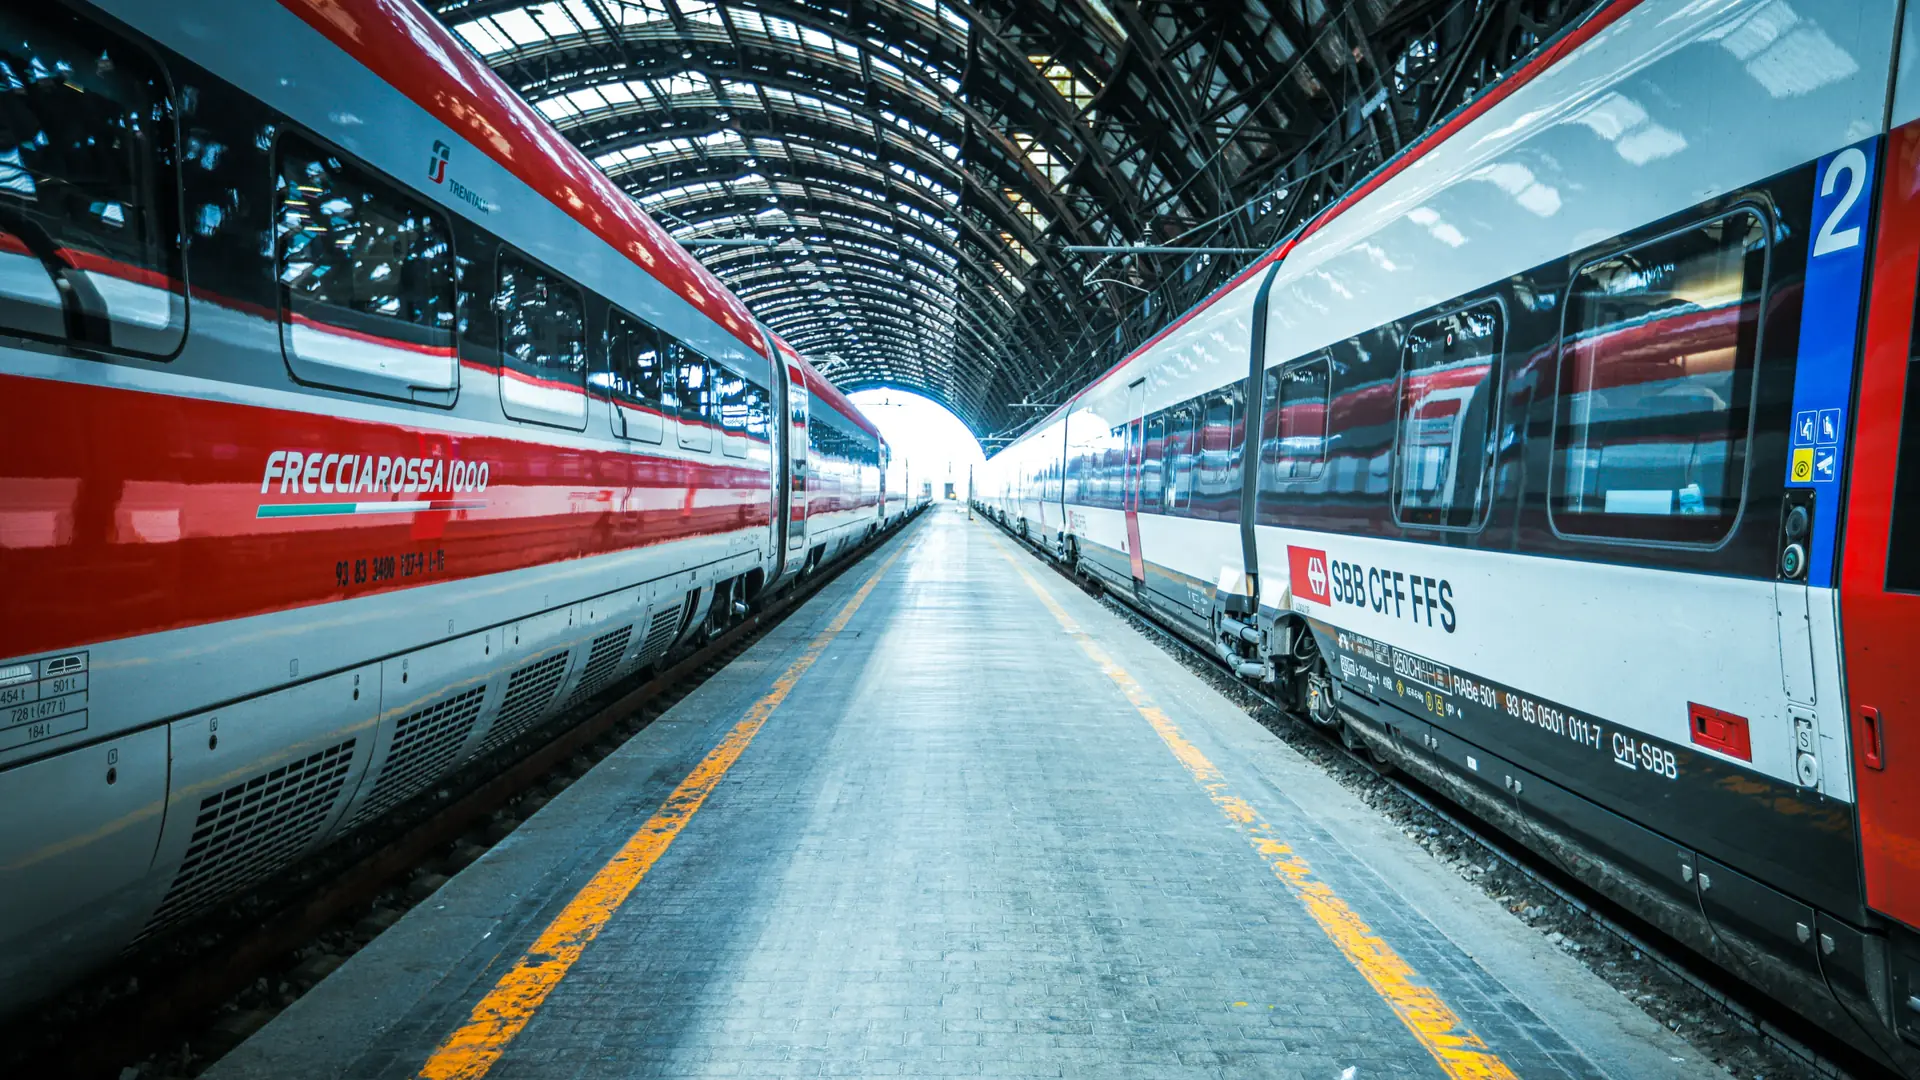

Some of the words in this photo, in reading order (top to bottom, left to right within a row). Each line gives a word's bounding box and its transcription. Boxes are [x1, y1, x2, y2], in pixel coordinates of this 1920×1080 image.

[1813, 148, 1867, 258] 2
[261, 450, 444, 494] FRECCIAROSSA
[446, 460, 490, 493] 1000
[335, 560, 349, 588] 93
[354, 558, 367, 585] 83
[372, 556, 396, 582] 3400
[1332, 560, 1366, 608] SBB
[1369, 567, 1405, 618] CFF
[1410, 574, 1456, 634] FFS
[0, 688, 18, 704] 454
[21, 688, 25, 701] t
[53, 679, 69, 693] 501
[72, 678, 76, 689] t
[11, 707, 29, 723] 728
[31, 706, 35, 718] t
[37, 700, 57, 717] (477
[28, 723, 44, 740] 184
[47, 722, 51, 735] t
[1453, 675, 1479, 703] RABe
[1480, 688, 1497, 710] 501
[1505, 693, 1519, 718] 93
[1522, 698, 1536, 724] 85
[1538, 705, 1565, 736] 0501
[1569, 716, 1602, 750] 011-7
[1612, 732, 1678, 780] CH-SBB
[1800, 731, 1809, 748] S
